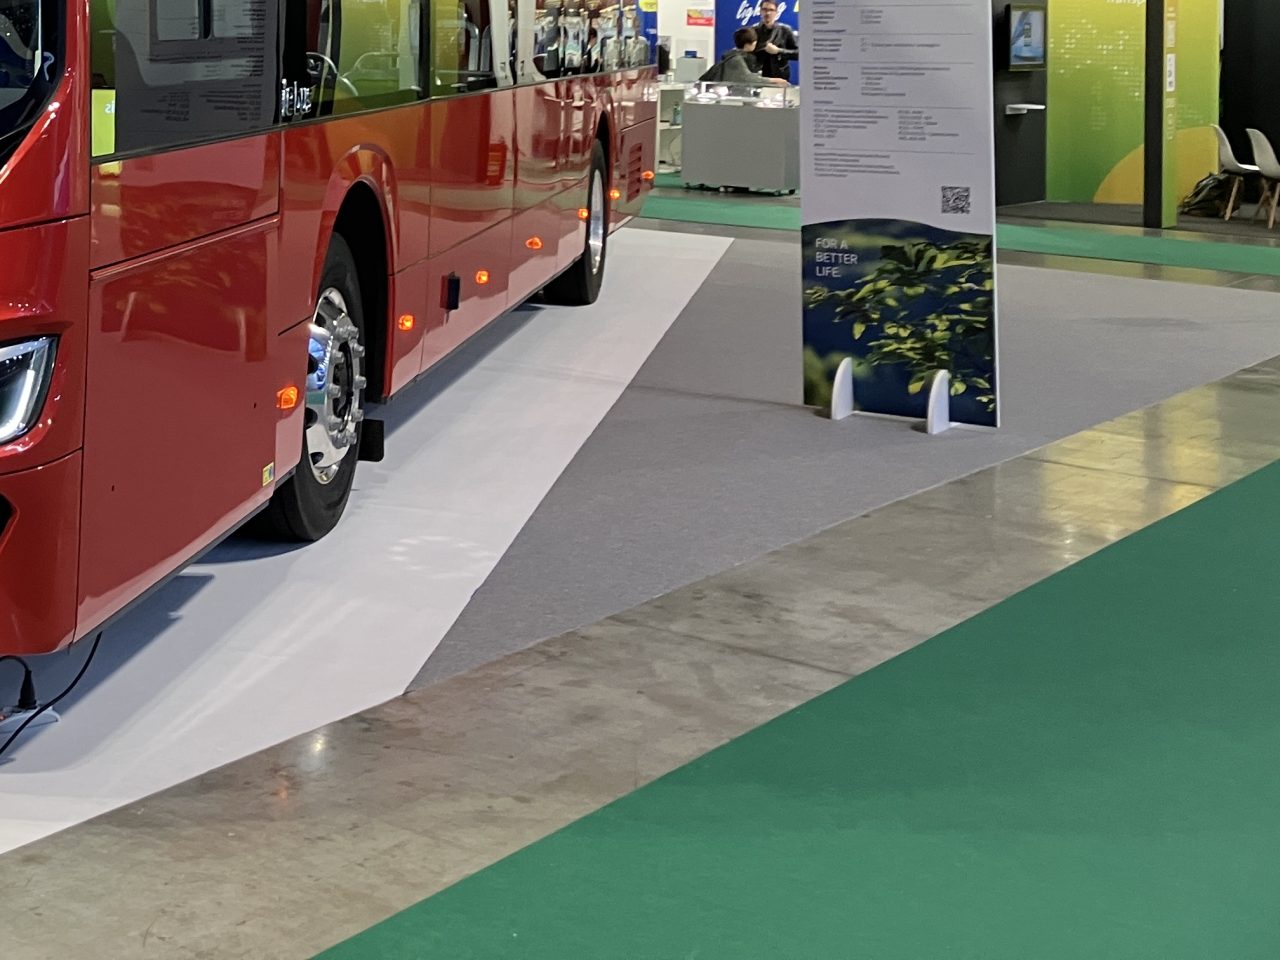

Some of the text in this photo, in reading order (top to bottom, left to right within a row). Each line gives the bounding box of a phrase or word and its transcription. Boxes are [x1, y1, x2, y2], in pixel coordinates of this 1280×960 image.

[815, 237, 849, 249] FOR A
[815, 251, 858, 265] BETTER
